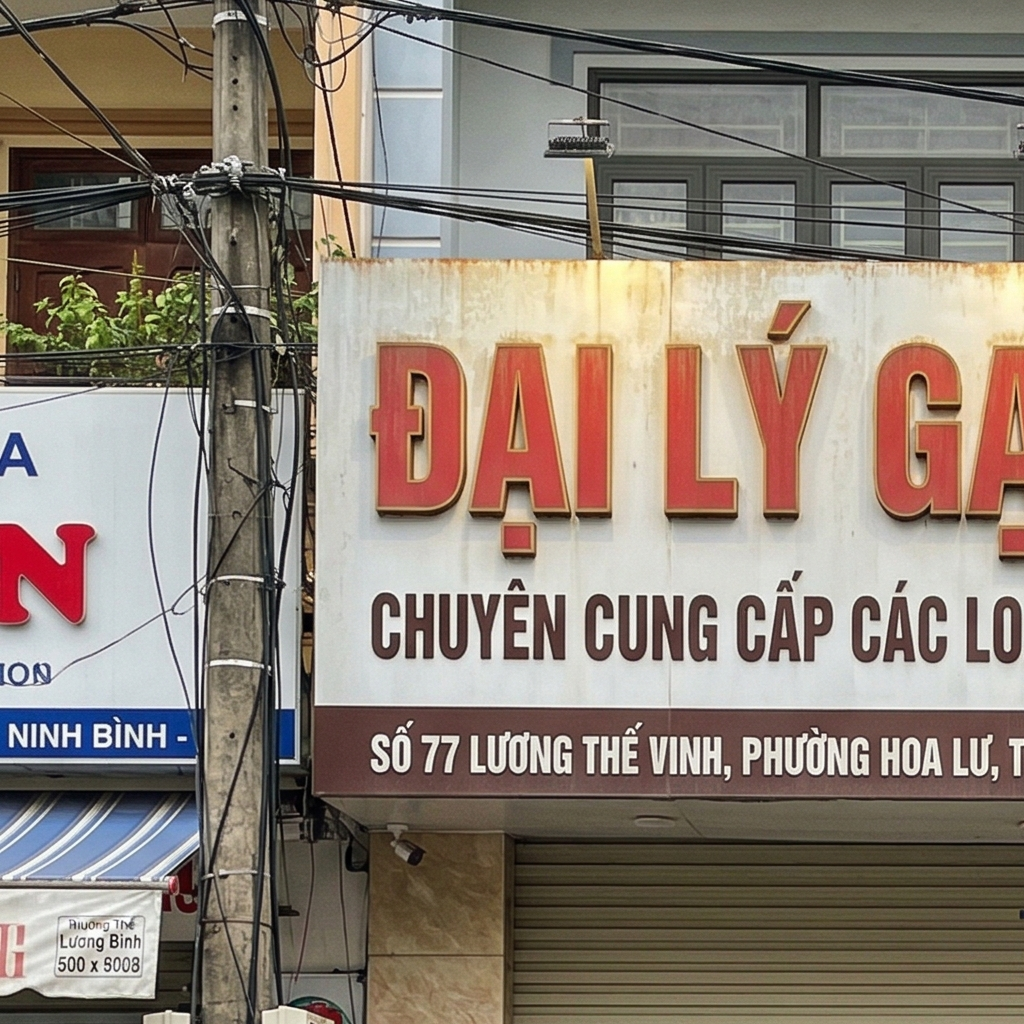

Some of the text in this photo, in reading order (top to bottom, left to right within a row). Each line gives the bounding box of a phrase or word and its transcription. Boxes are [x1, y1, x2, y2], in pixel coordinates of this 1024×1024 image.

[370, 342, 613, 558] ĐẠI
[664, 301, 828, 520] LÝ
[371, 579, 566, 661] CHUYÊN
[584, 595, 717, 663] CUNG
[737, 571, 834, 663] CẤP
[852, 581, 948, 664] CÁC
[8, 723, 81, 748] NINH
[93, 716, 166, 748] BÌNH
[370, 720, 414, 774] SỐ
[421, 735, 460, 774] 77
[470, 732, 572, 775] LƯƠNG
[583, 722, 643, 775] THẾ
[650, 736, 732, 782] VINH,
[743, 727, 870, 777] PHƯỜNG
[881, 737, 943, 777] HOA
[953, 735, 999, 781] LƯ,
[58, 956, 85, 972] 500
